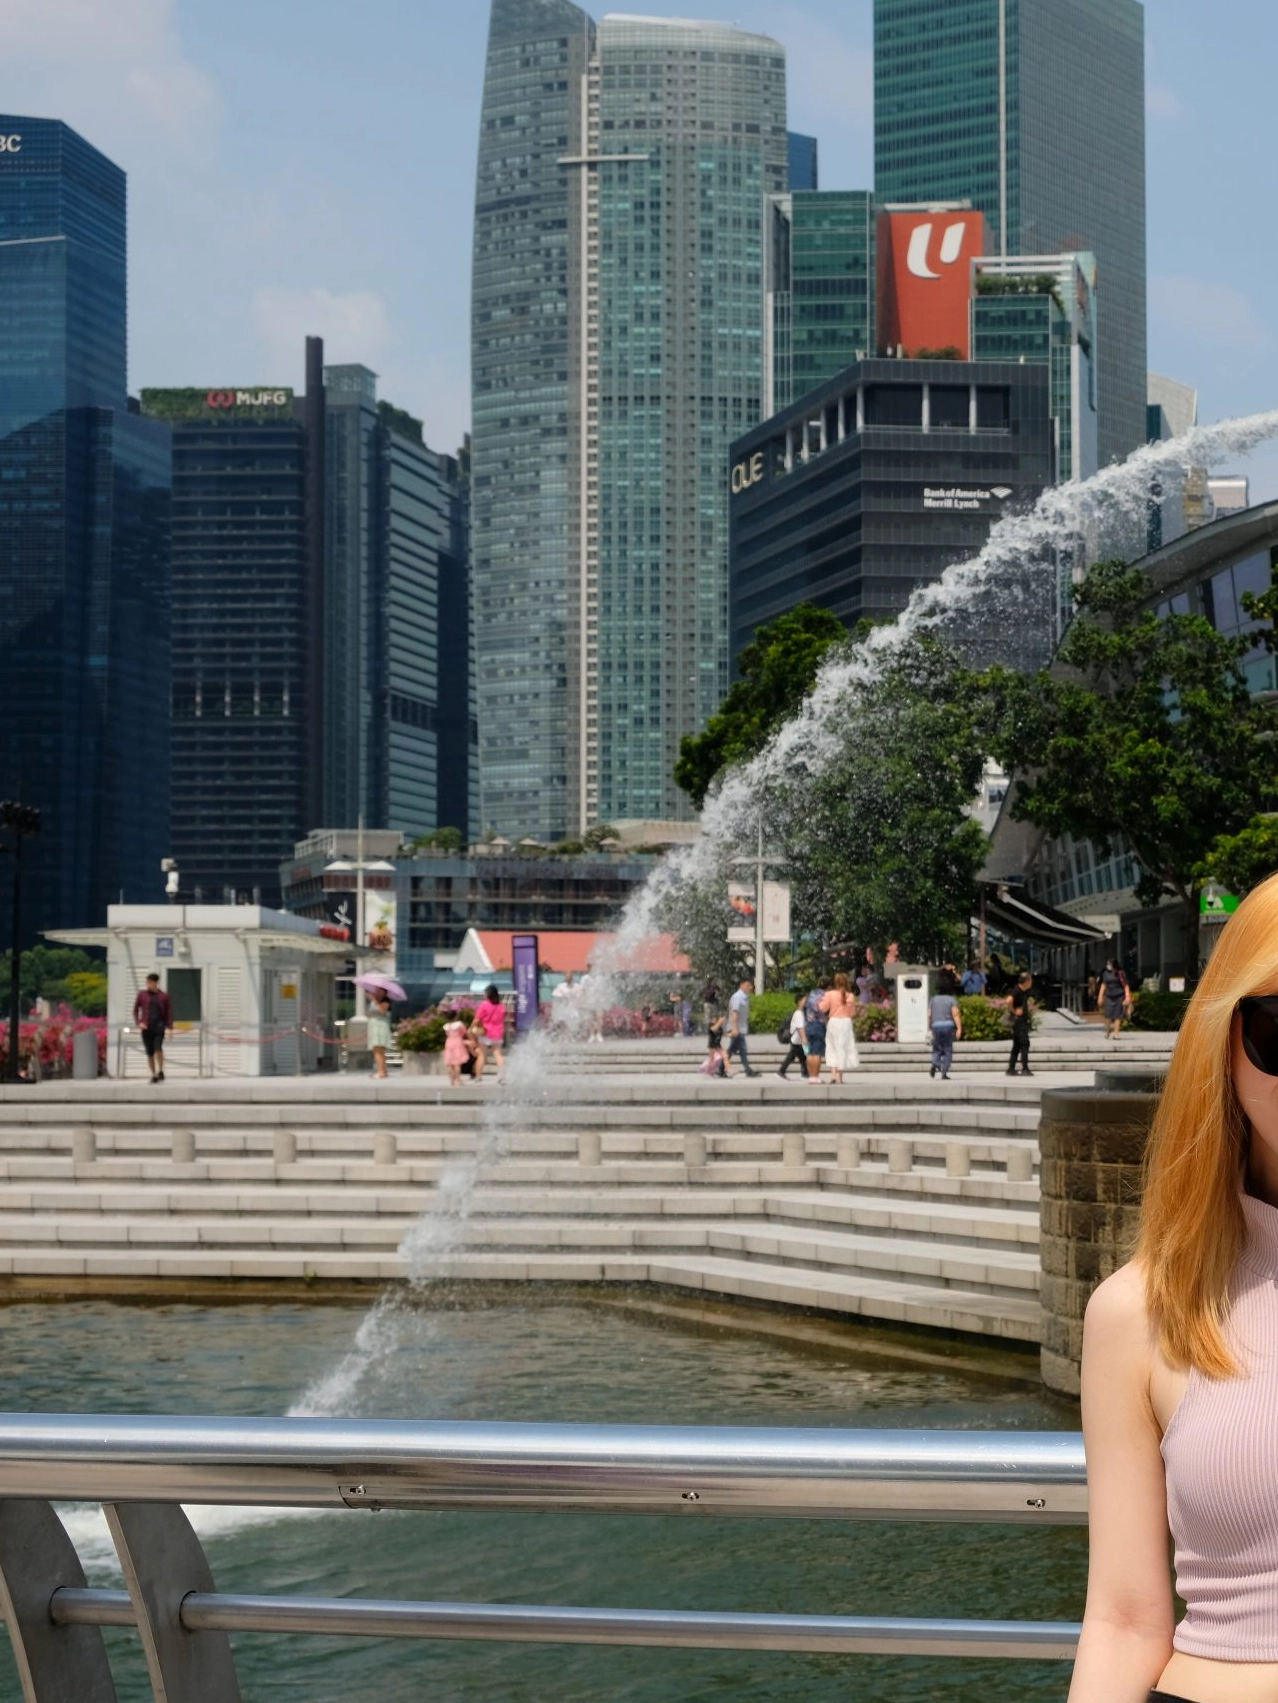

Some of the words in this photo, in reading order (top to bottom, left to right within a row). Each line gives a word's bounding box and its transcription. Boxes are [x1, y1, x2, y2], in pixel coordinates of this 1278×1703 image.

[236, 390, 287, 406] MUFG
[731, 451, 764, 494] OUE
[923, 487, 945, 498] Bank
[955, 488, 991, 499] America
[923, 498, 953, 509] Merrill
[954, 499, 980, 510] Lynch
